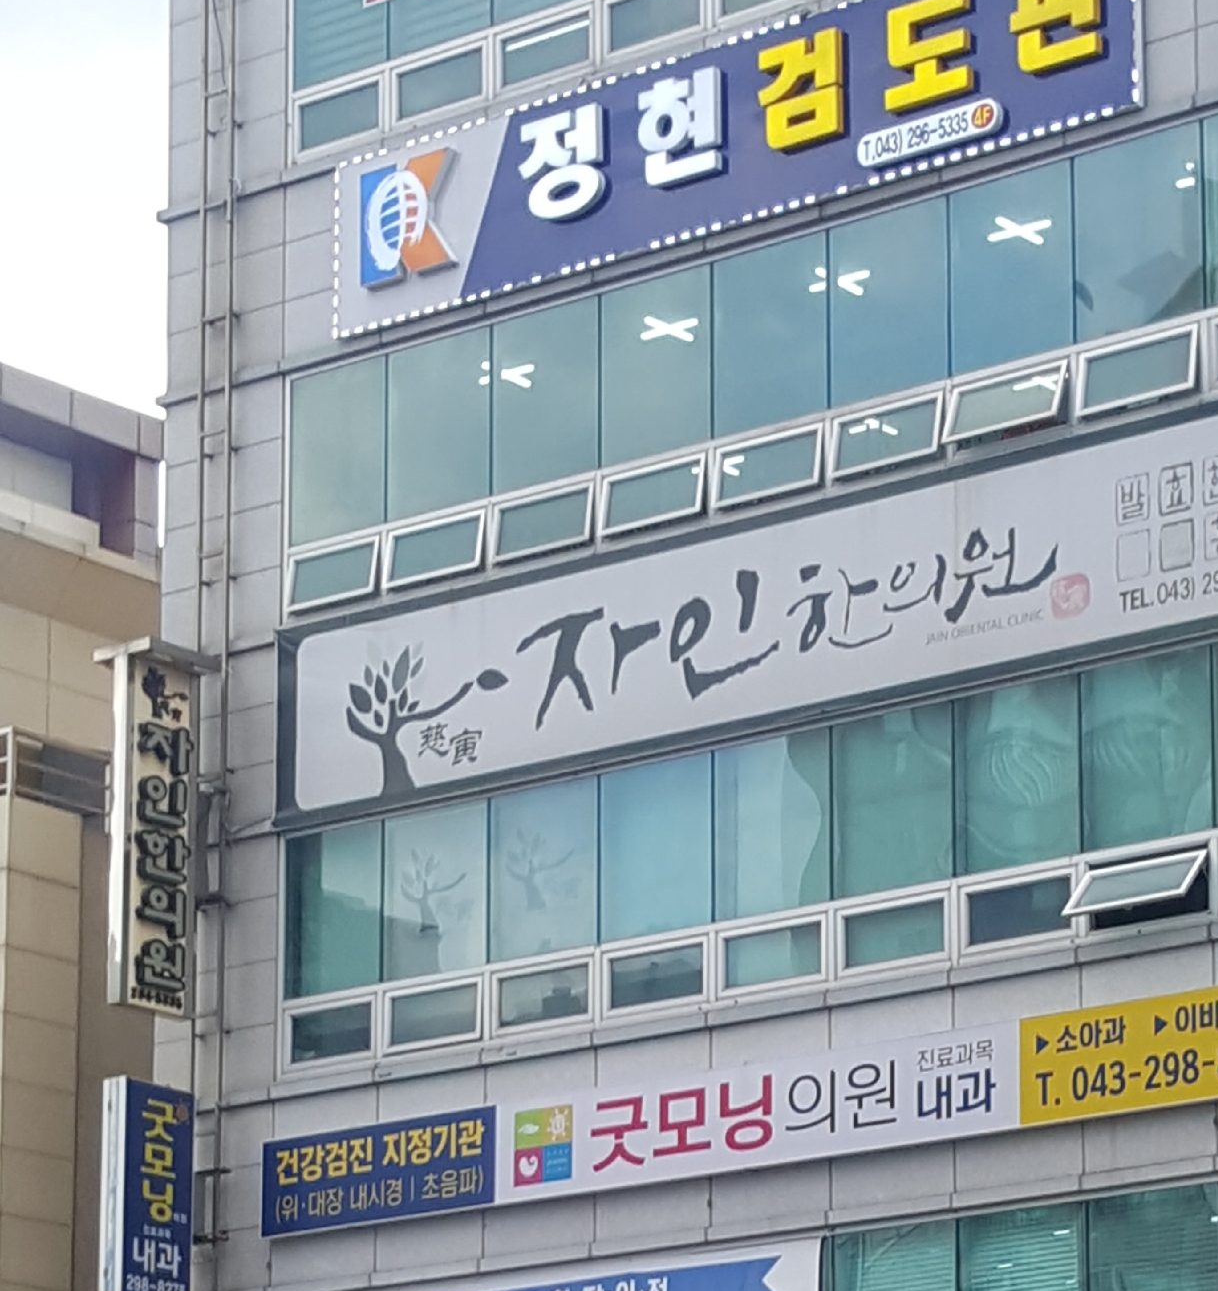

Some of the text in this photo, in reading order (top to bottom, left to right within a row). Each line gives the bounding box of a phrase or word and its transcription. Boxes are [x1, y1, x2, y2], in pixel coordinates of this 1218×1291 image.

[906, 110, 968, 146] 296-5335
[971, 104, 994, 128] 4F
[515, 529, 1059, 729] 자인한의원
[917, 1038, 994, 1072] 진료과목
[1057, 1018, 1127, 1054] 소아과
[917, 1072, 996, 1121] 내과
[276, 1120, 484, 1185] 건강검진 지정기관
[347, 1179, 404, 1216] 내시경
[132, 1236, 182, 1279] 내과
